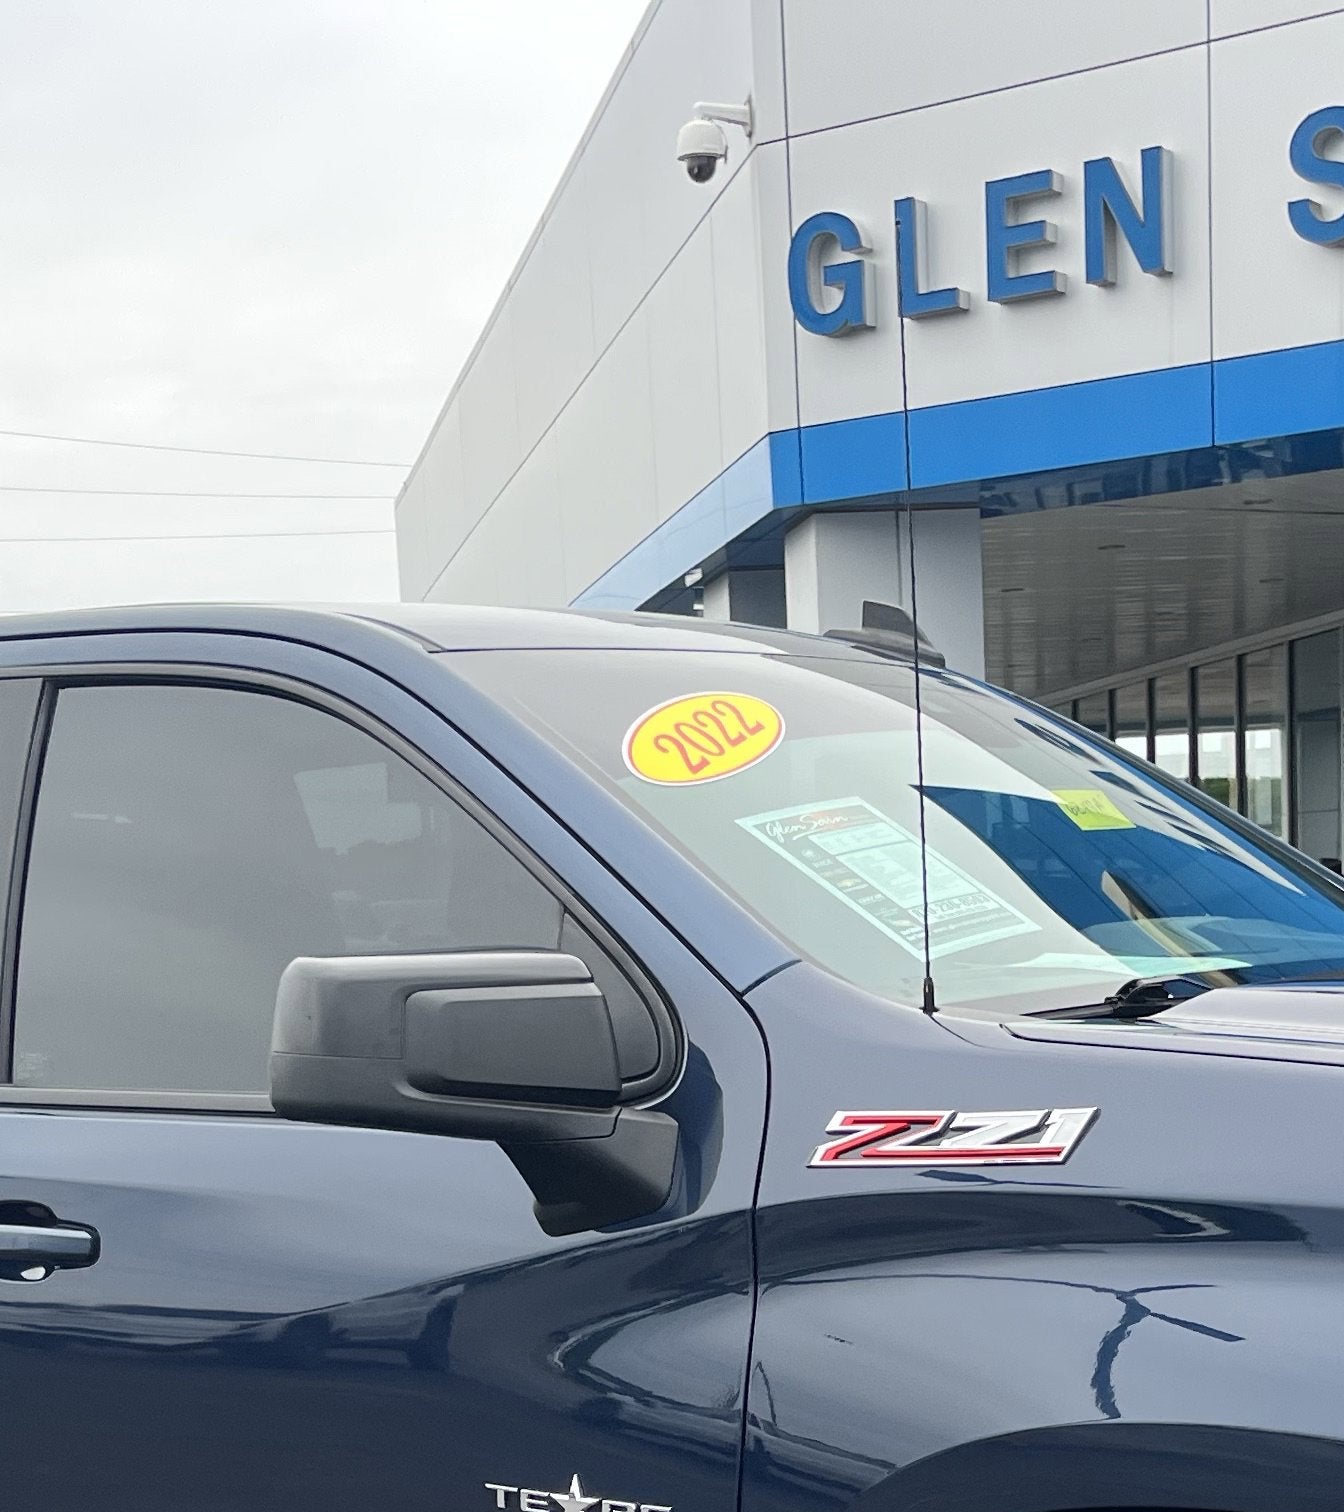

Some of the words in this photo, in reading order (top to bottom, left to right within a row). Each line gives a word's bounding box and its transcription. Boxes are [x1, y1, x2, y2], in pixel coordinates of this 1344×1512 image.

[788, 145, 1173, 338] GLEN
[653, 700, 766, 774] 2022
[765, 819, 808, 843] Glen
[806, 1106, 1102, 1168] Z71
